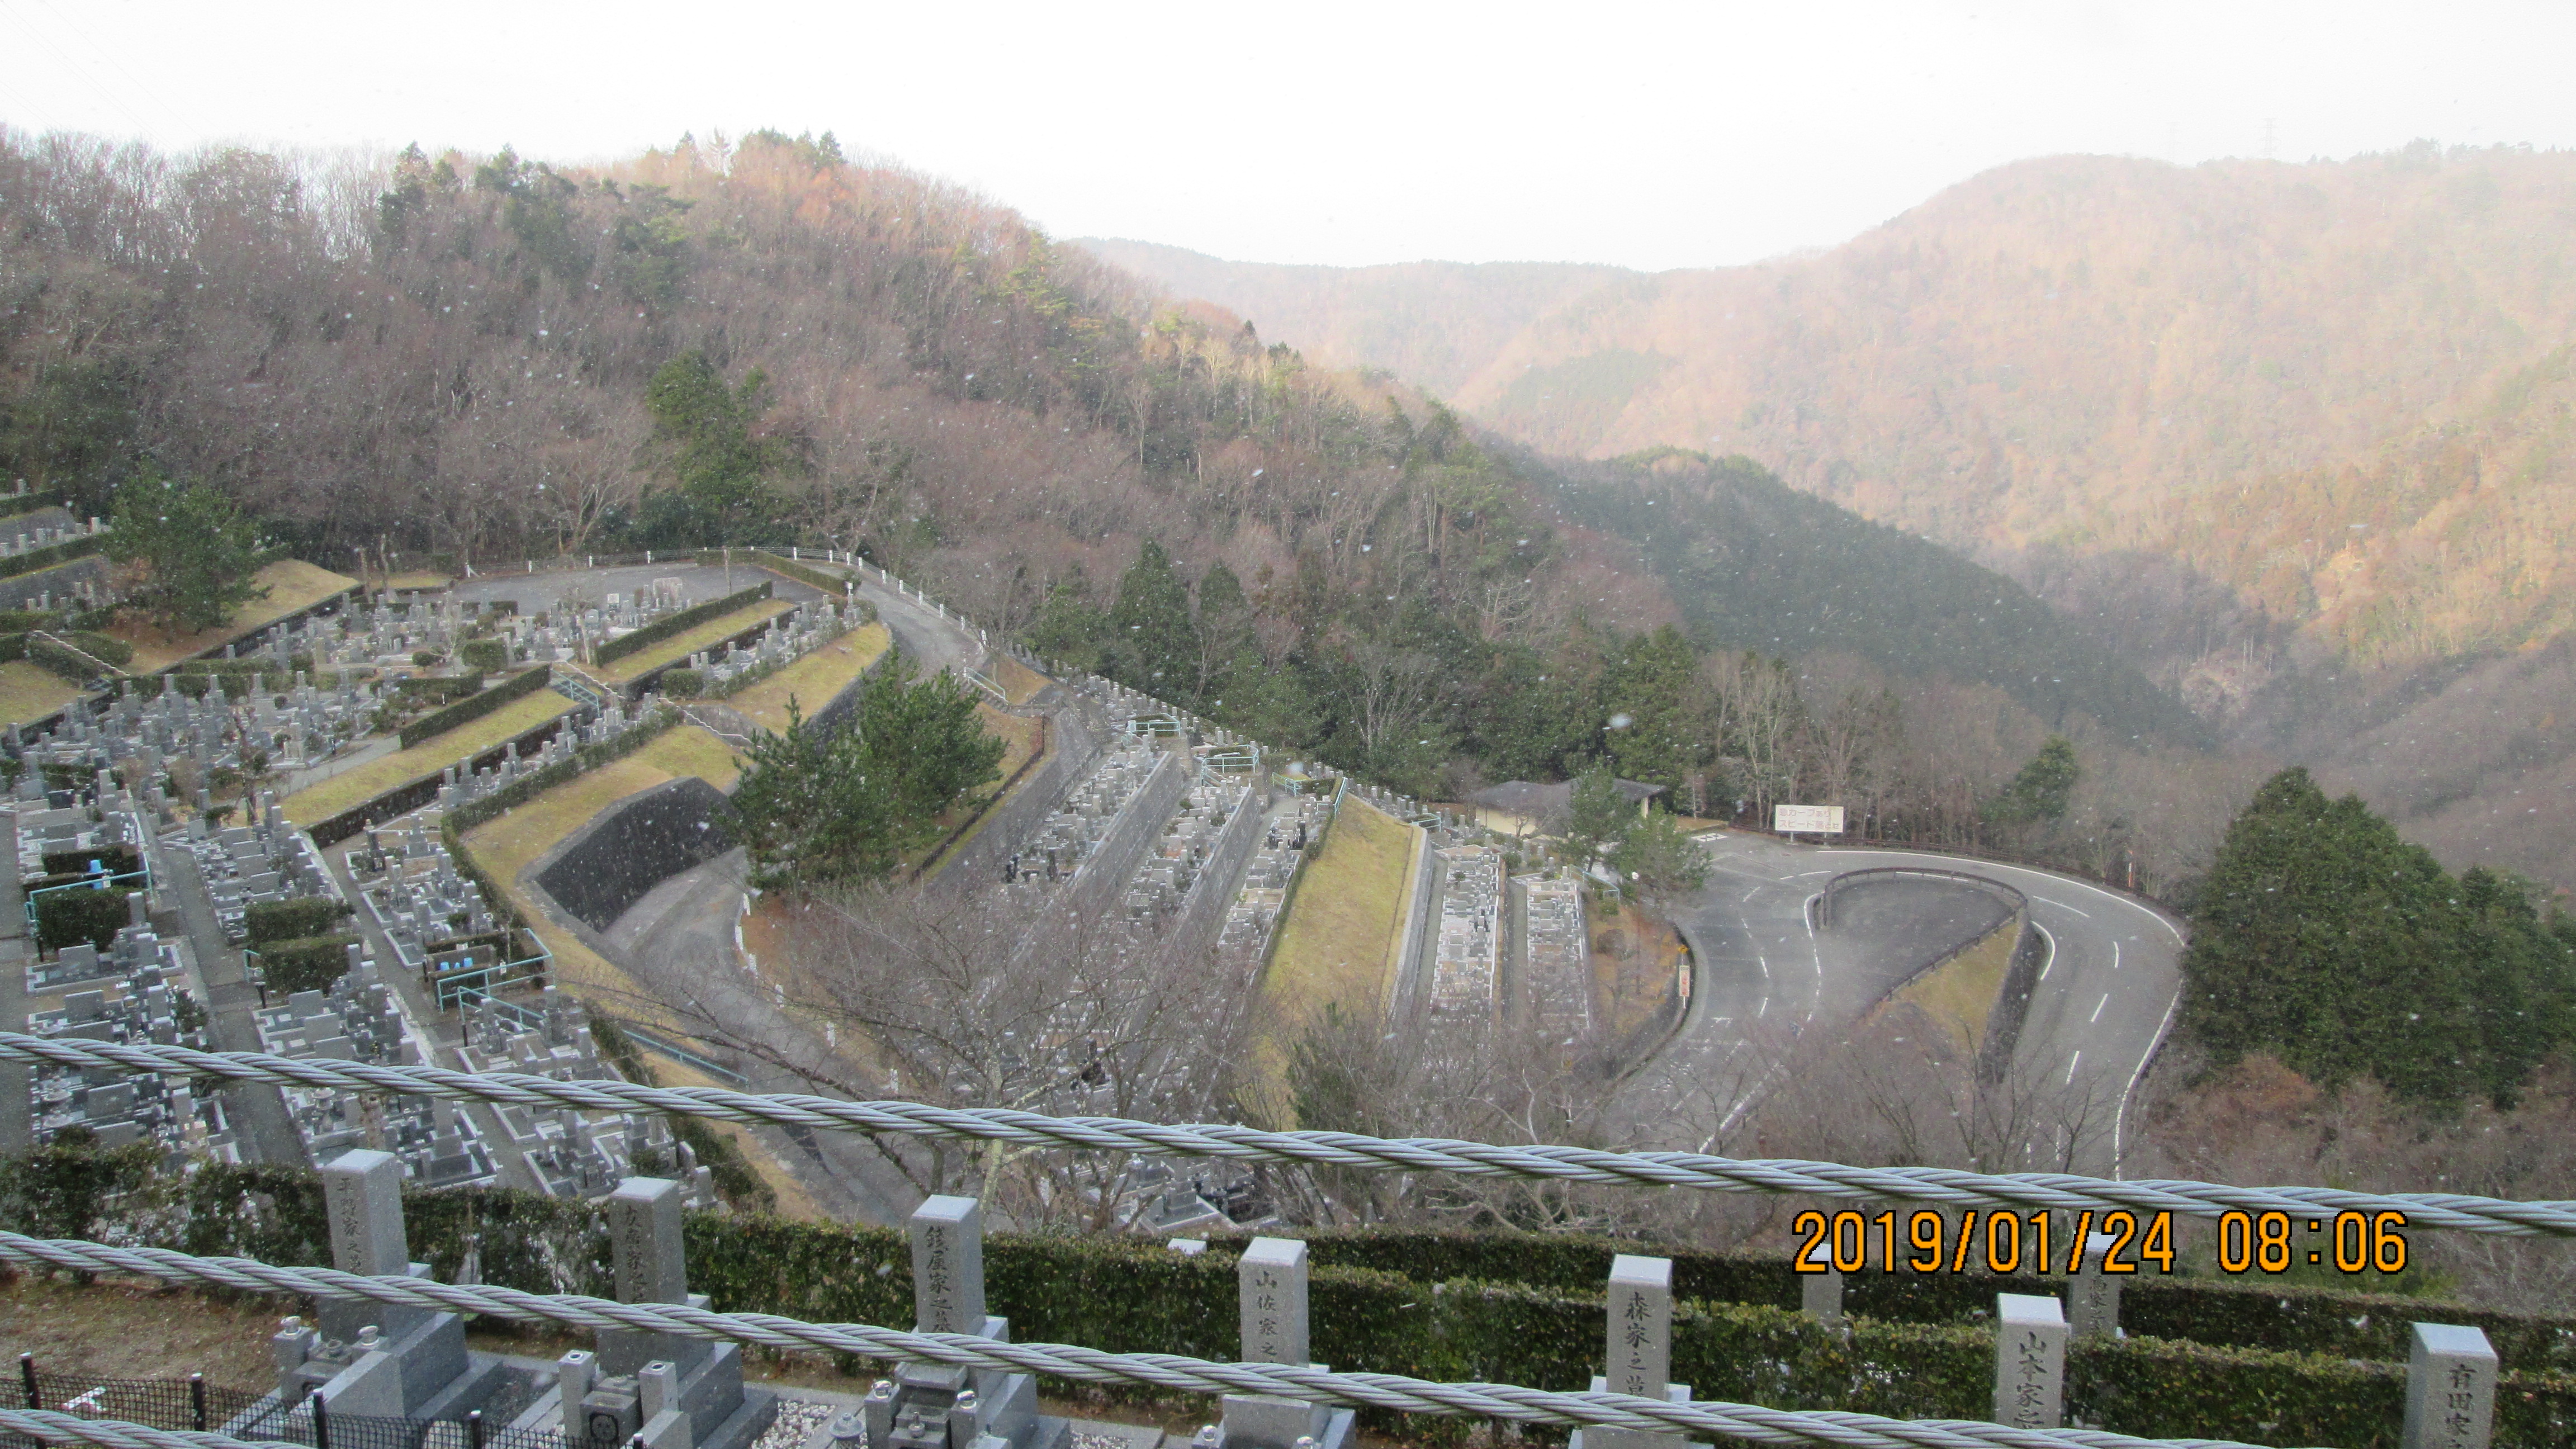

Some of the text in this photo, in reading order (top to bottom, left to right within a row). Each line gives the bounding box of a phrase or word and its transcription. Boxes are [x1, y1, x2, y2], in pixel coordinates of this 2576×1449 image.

[1256, 1270, 1278, 1362] 山佐家之
[2014, 1330, 2048, 1429] 山本家之
